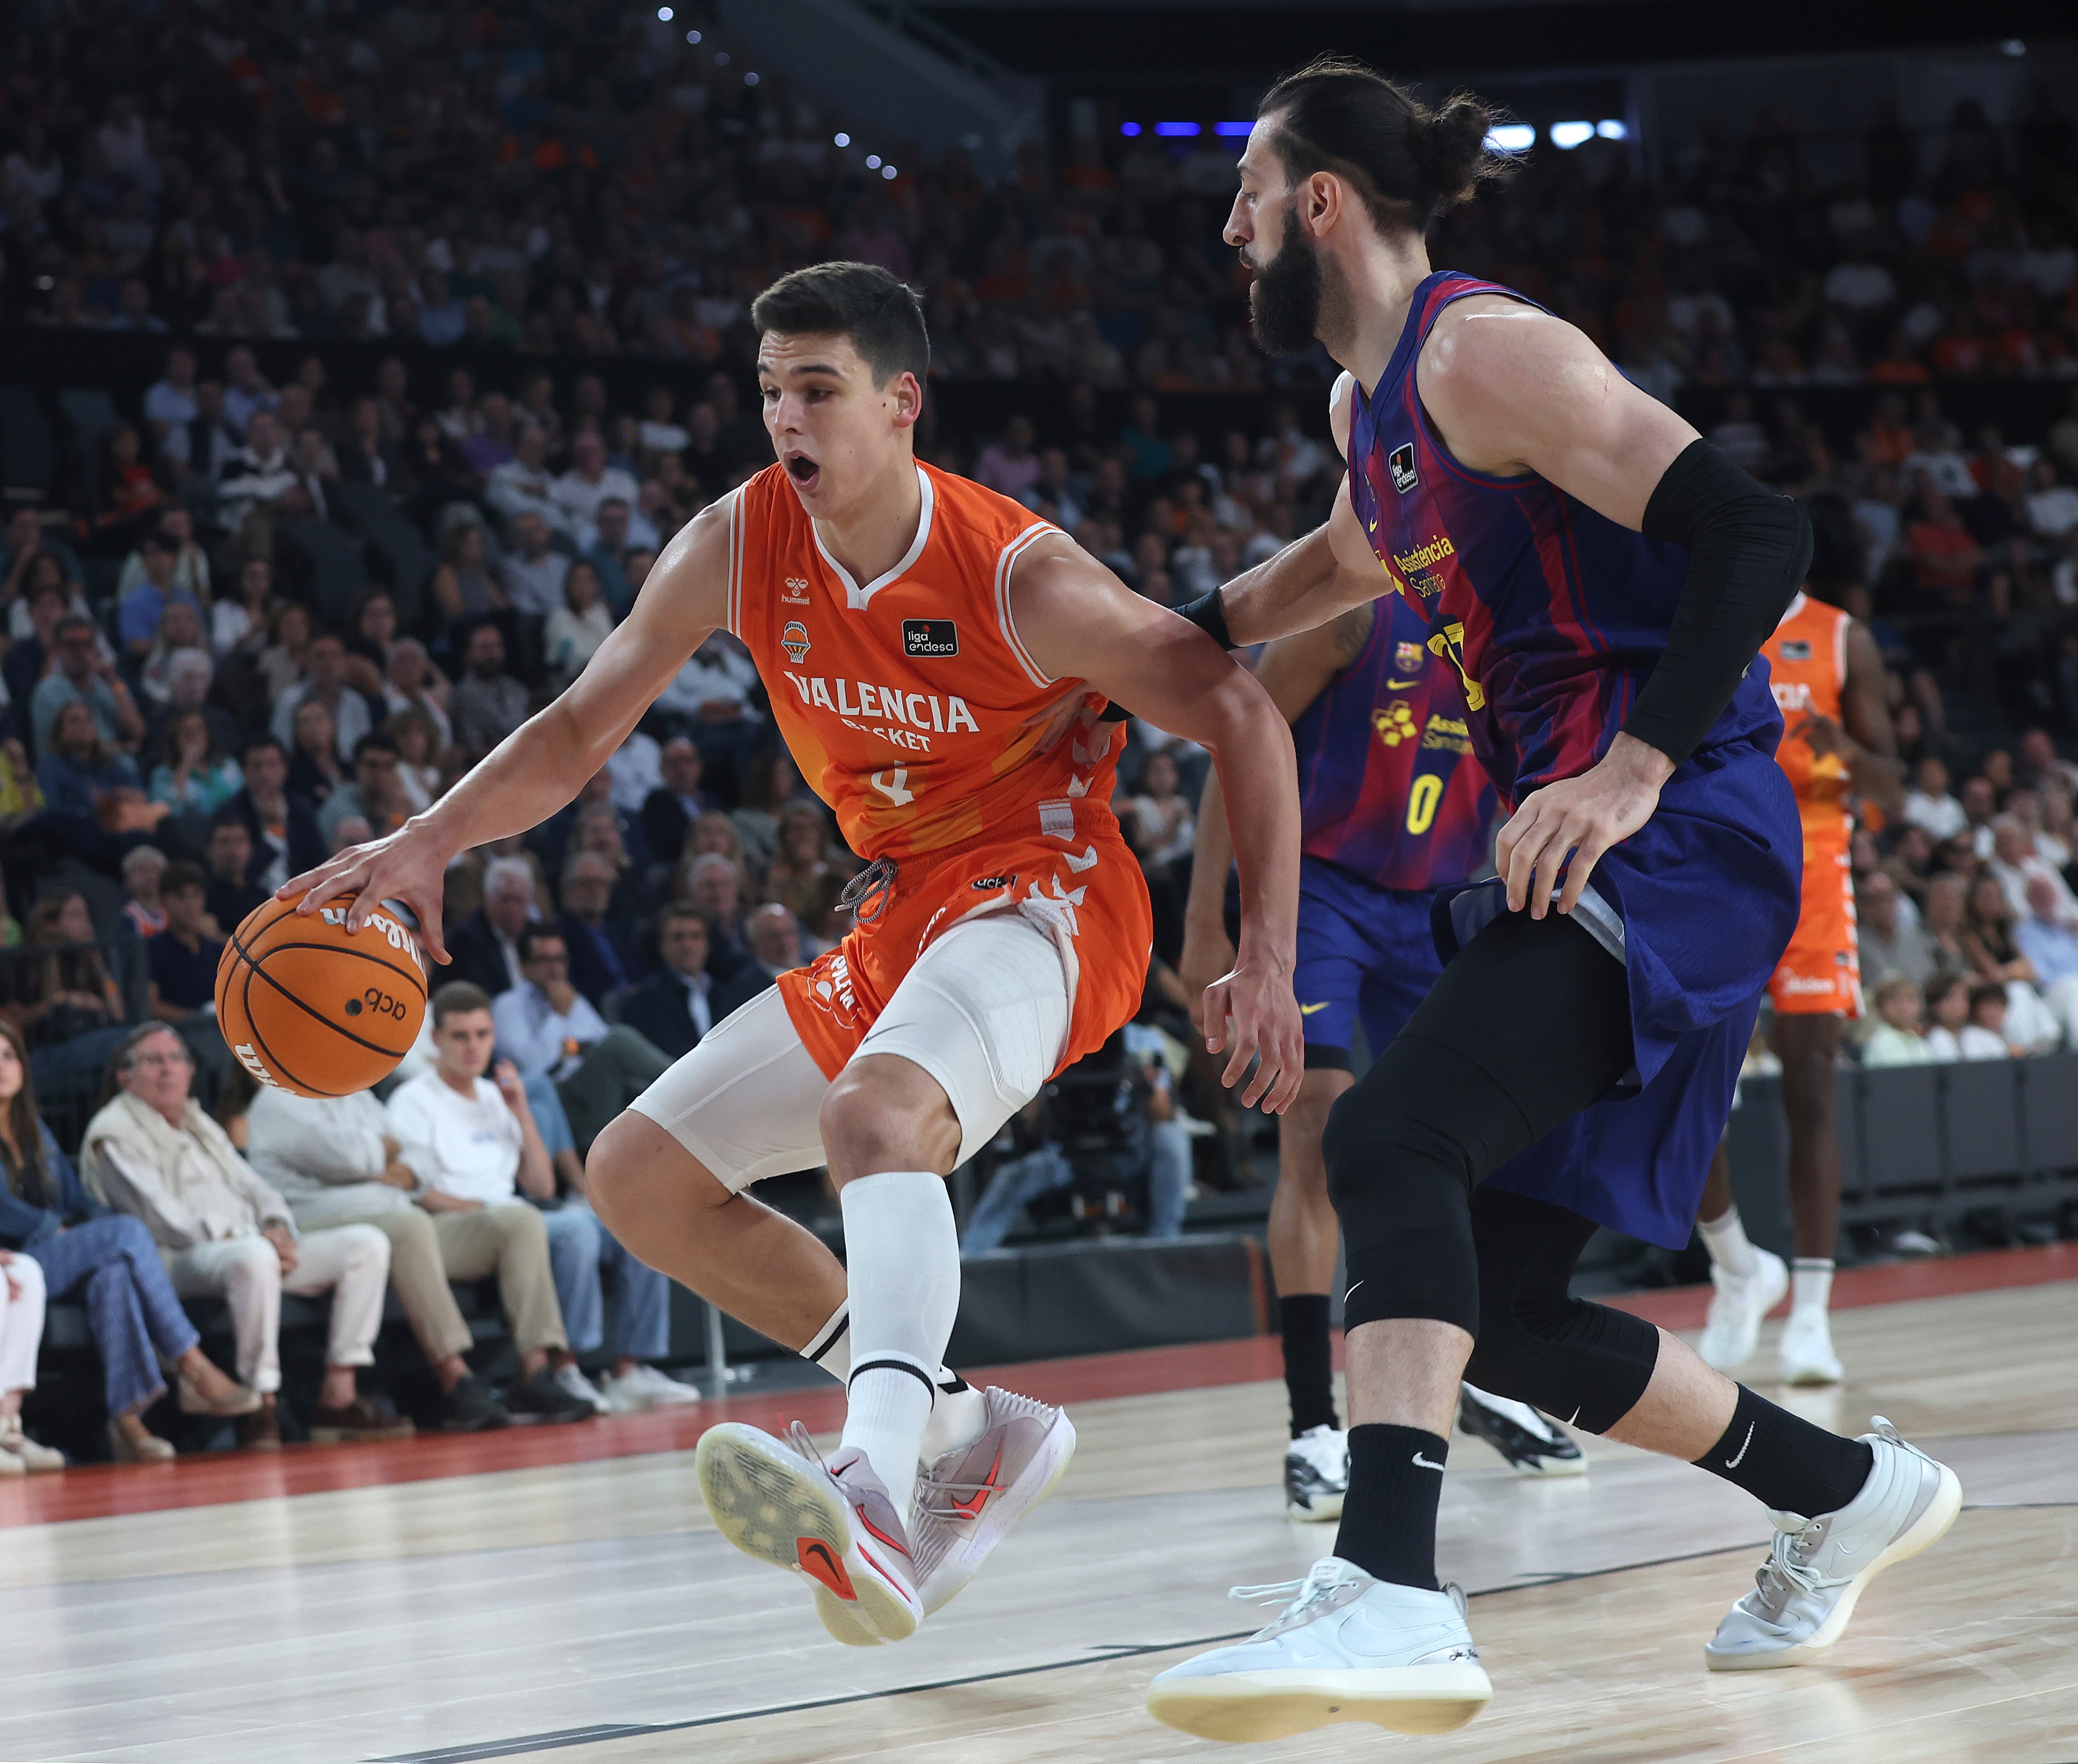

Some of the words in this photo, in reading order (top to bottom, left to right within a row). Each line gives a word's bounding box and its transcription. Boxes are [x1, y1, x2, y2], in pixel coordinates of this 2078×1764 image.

[1397, 472, 1415, 487] endesa
[782, 594, 810, 605] hummel
[908, 630, 928, 643] liga
[909, 641, 954, 652] endesa
[783, 671, 980, 733] VALENCIA
[841, 718, 931, 752] BSKET
[871, 760, 914, 807] 4
[1406, 773, 1444, 835] 0
[319, 907, 427, 984] Wilsn
[364, 987, 407, 1021] acb
